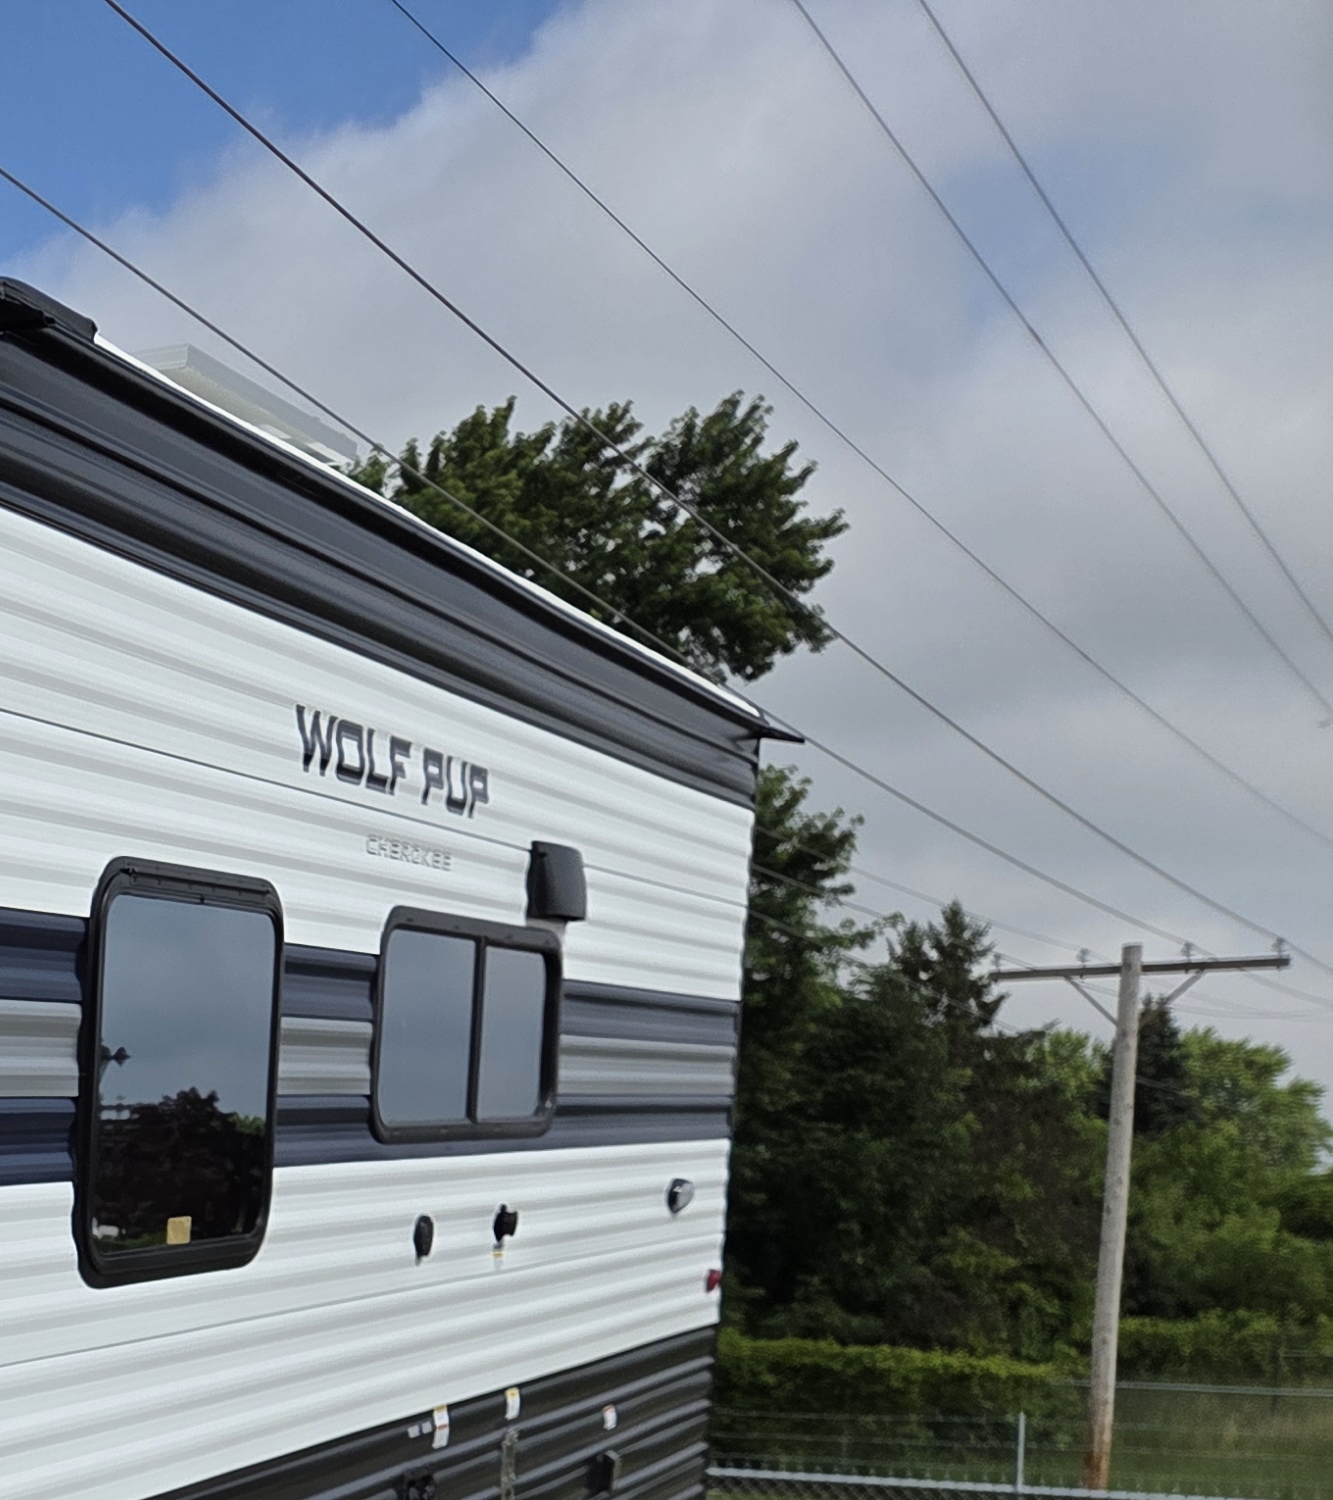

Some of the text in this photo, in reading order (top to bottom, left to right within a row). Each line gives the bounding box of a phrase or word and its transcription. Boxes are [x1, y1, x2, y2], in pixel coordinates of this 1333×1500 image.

[295, 703, 490, 819] WOLF PUP
[365, 833, 452, 871] CHEROKEE
